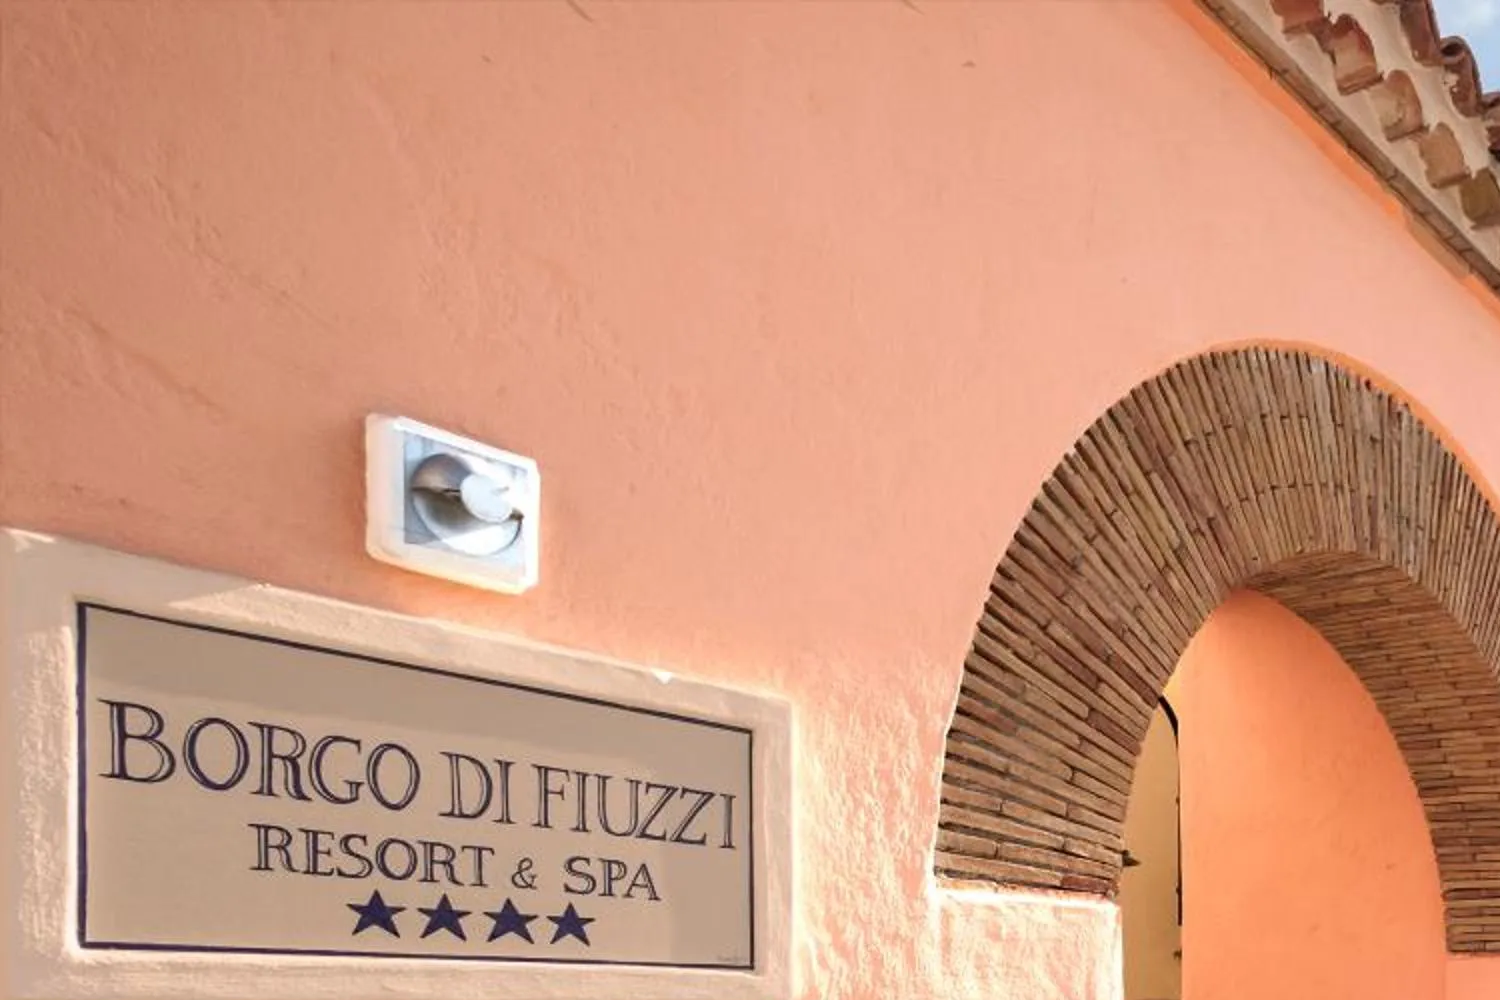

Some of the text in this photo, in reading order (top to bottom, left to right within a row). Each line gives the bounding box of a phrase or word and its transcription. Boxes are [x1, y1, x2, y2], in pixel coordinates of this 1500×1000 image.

[96, 698, 737, 850] BORGO DI FIUZZI
[247, 823, 662, 902] RESORT & SPA
